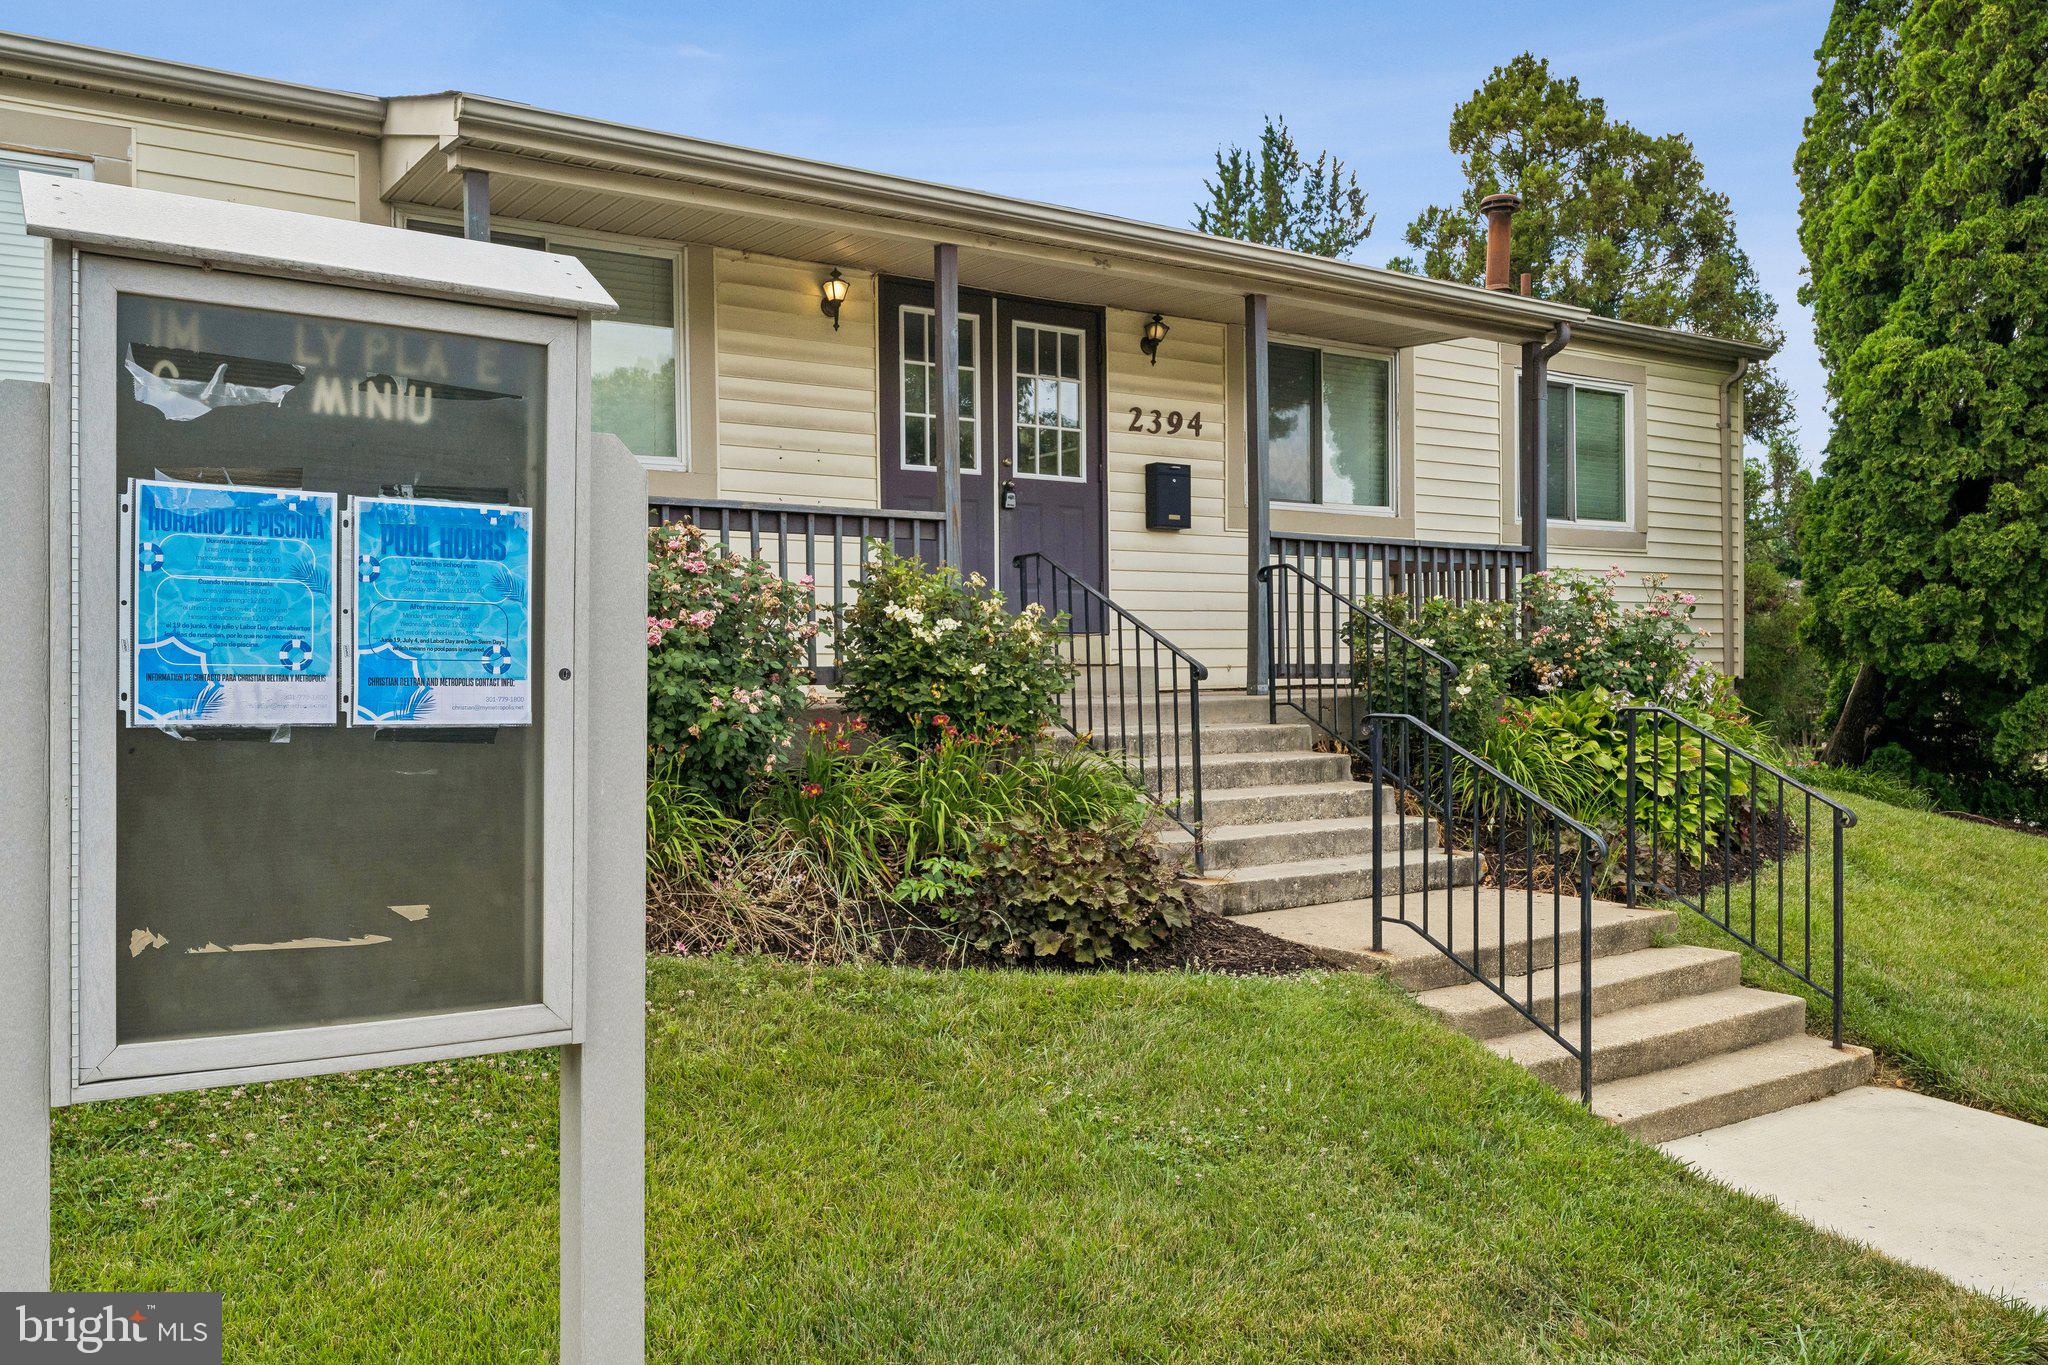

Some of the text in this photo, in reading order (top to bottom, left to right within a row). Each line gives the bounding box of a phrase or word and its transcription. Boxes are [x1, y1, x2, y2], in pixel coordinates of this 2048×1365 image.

[1128, 406, 1202, 437] 2394
[148, 508, 324, 539] HORARIO DE PISCINA
[381, 525, 507, 561] POOL HOURS
[410, 560, 431, 568] During
[185, 673, 191, 681] DE
[193, 673, 220, 681] CONTACTO
[238, 673, 265, 682] CHRISTIAN
[267, 674, 288, 682] BELTRAN
[295, 674, 326, 682] METROPOLIS
[368, 677, 398, 686] CHRISTIAN
[400, 677, 425, 686] BELTRAN
[426, 677, 439, 686] AND
[440, 678, 474, 687] METROPOLIS
[475, 678, 499, 687] CONTACT
